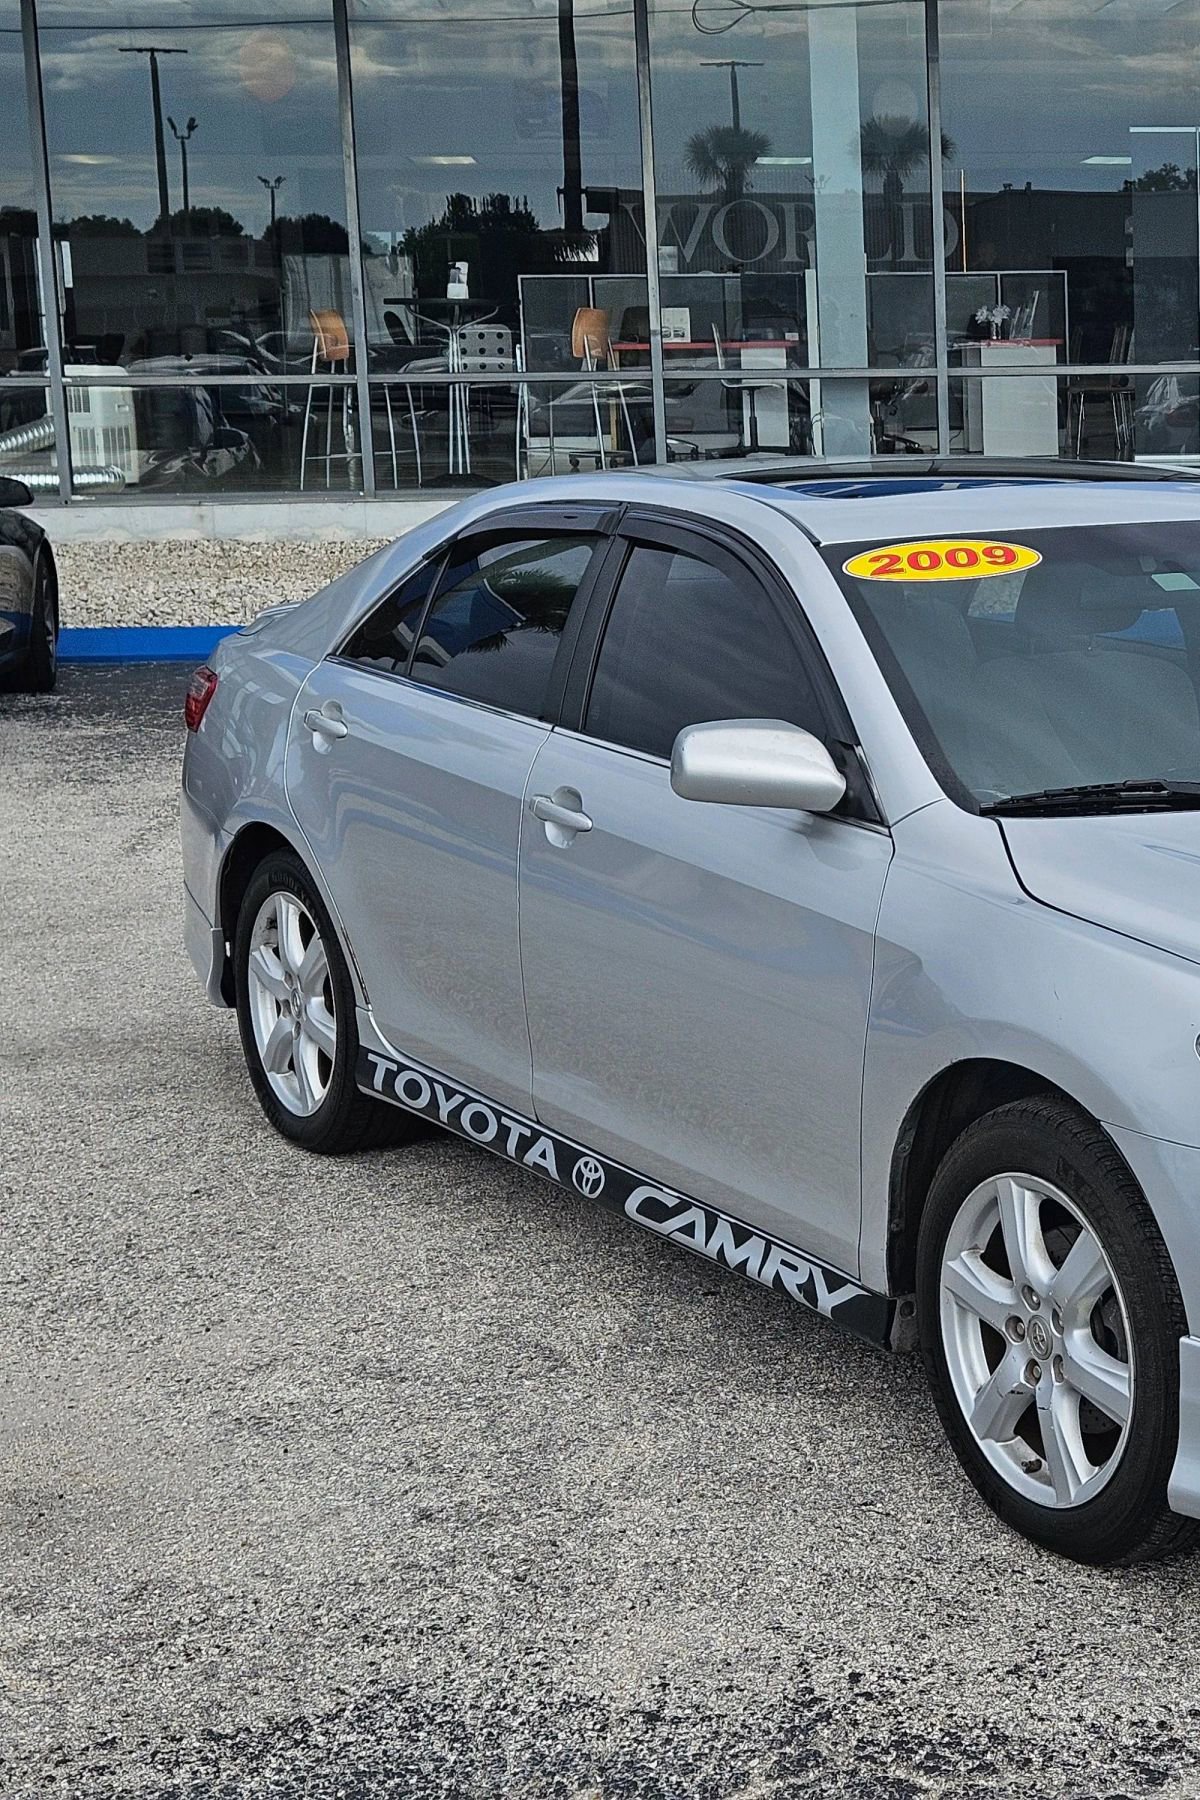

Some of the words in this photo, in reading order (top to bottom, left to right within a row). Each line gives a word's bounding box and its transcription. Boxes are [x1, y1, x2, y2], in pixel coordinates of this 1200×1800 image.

[869, 545, 1017, 576] 2009
[367, 1052, 561, 1182] TOYOTA
[624, 1185, 872, 1319] CAMRY
